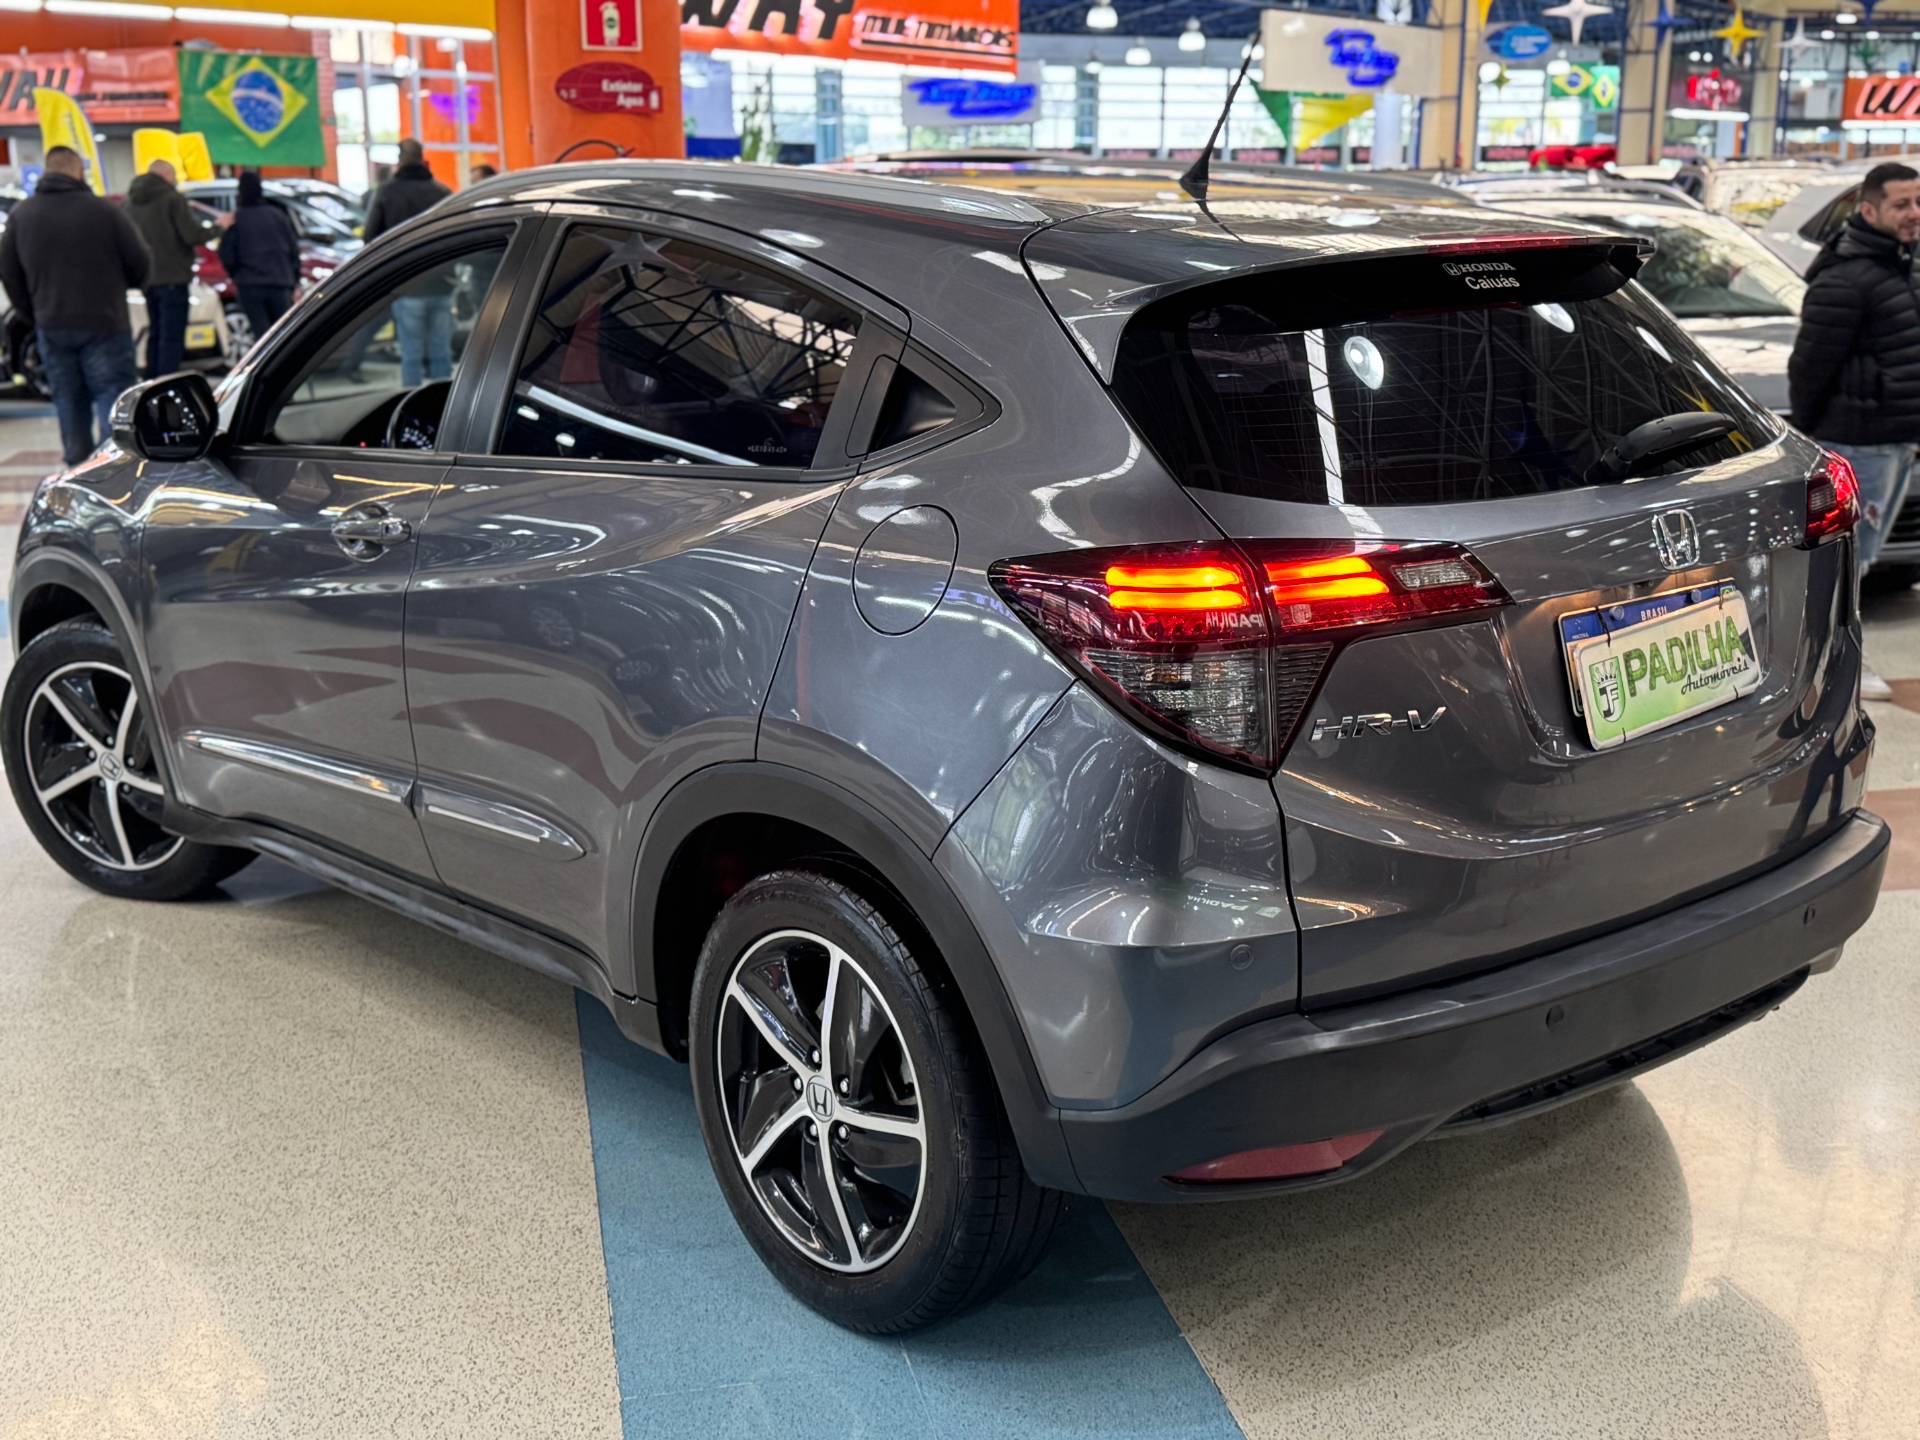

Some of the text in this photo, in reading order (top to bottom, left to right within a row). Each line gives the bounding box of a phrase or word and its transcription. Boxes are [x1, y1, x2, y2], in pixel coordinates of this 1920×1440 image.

[1459, 262, 1516, 273] HONDA
[1465, 274, 1520, 290] Caiuás
[1622, 615, 1747, 698] PADILHA
[1680, 657, 1750, 696] Automóveis
[1310, 706, 1447, 741] HR-V
